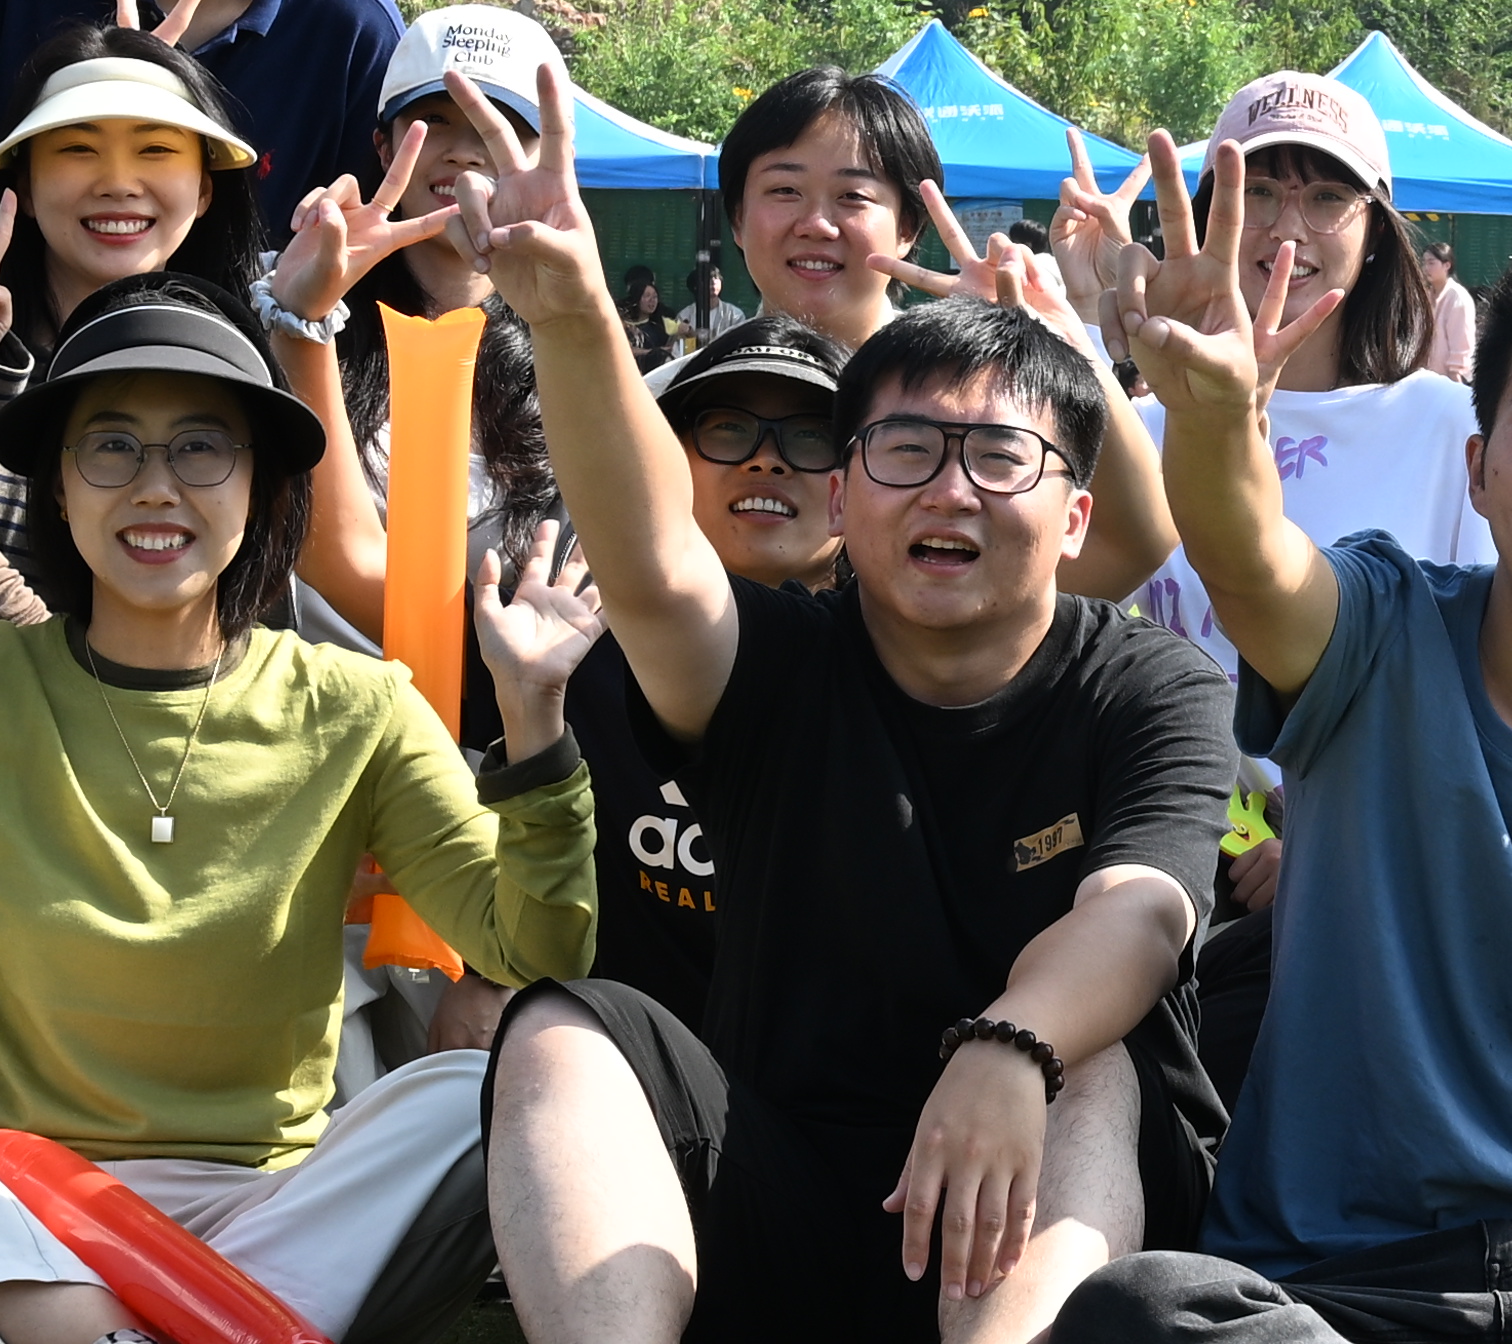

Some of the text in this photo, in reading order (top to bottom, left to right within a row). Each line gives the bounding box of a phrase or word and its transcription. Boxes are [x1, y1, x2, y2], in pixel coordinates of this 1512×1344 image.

[441, 35, 512, 58] Sleeping
[446, 23, 513, 44] Monday
[454, 51, 494, 66] Club
[1247, 86, 1348, 134] WELLNESS
[1038, 826, 1063, 855] 1997
[639, 869, 716, 912] REAL
